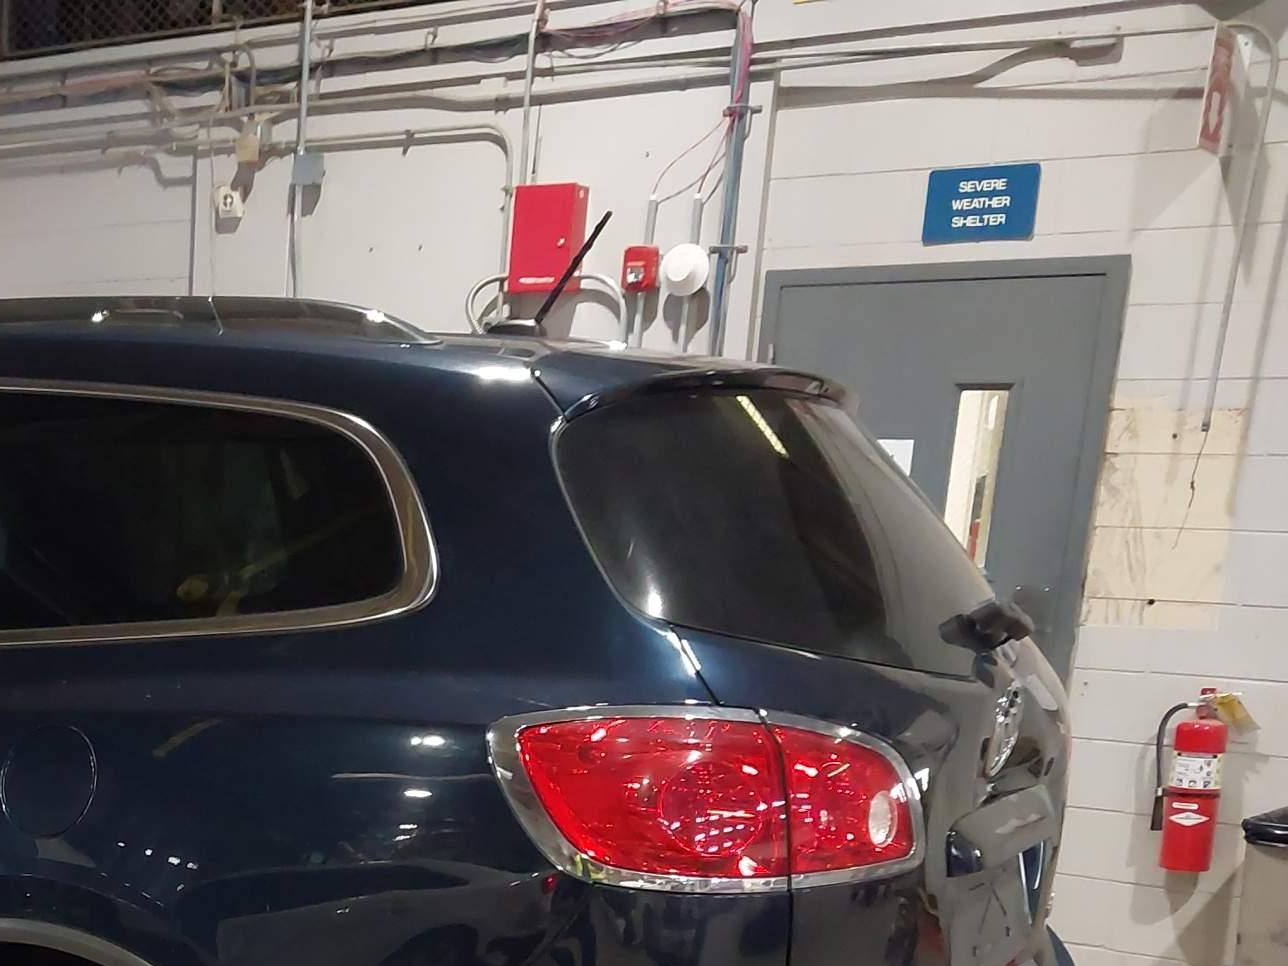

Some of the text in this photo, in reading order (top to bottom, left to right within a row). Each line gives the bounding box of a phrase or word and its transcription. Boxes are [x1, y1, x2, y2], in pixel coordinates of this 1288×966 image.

[958, 179, 1008, 192] SEVERE
[952, 196, 1011, 210] WEATHER
[951, 214, 1006, 227] SHELTER
